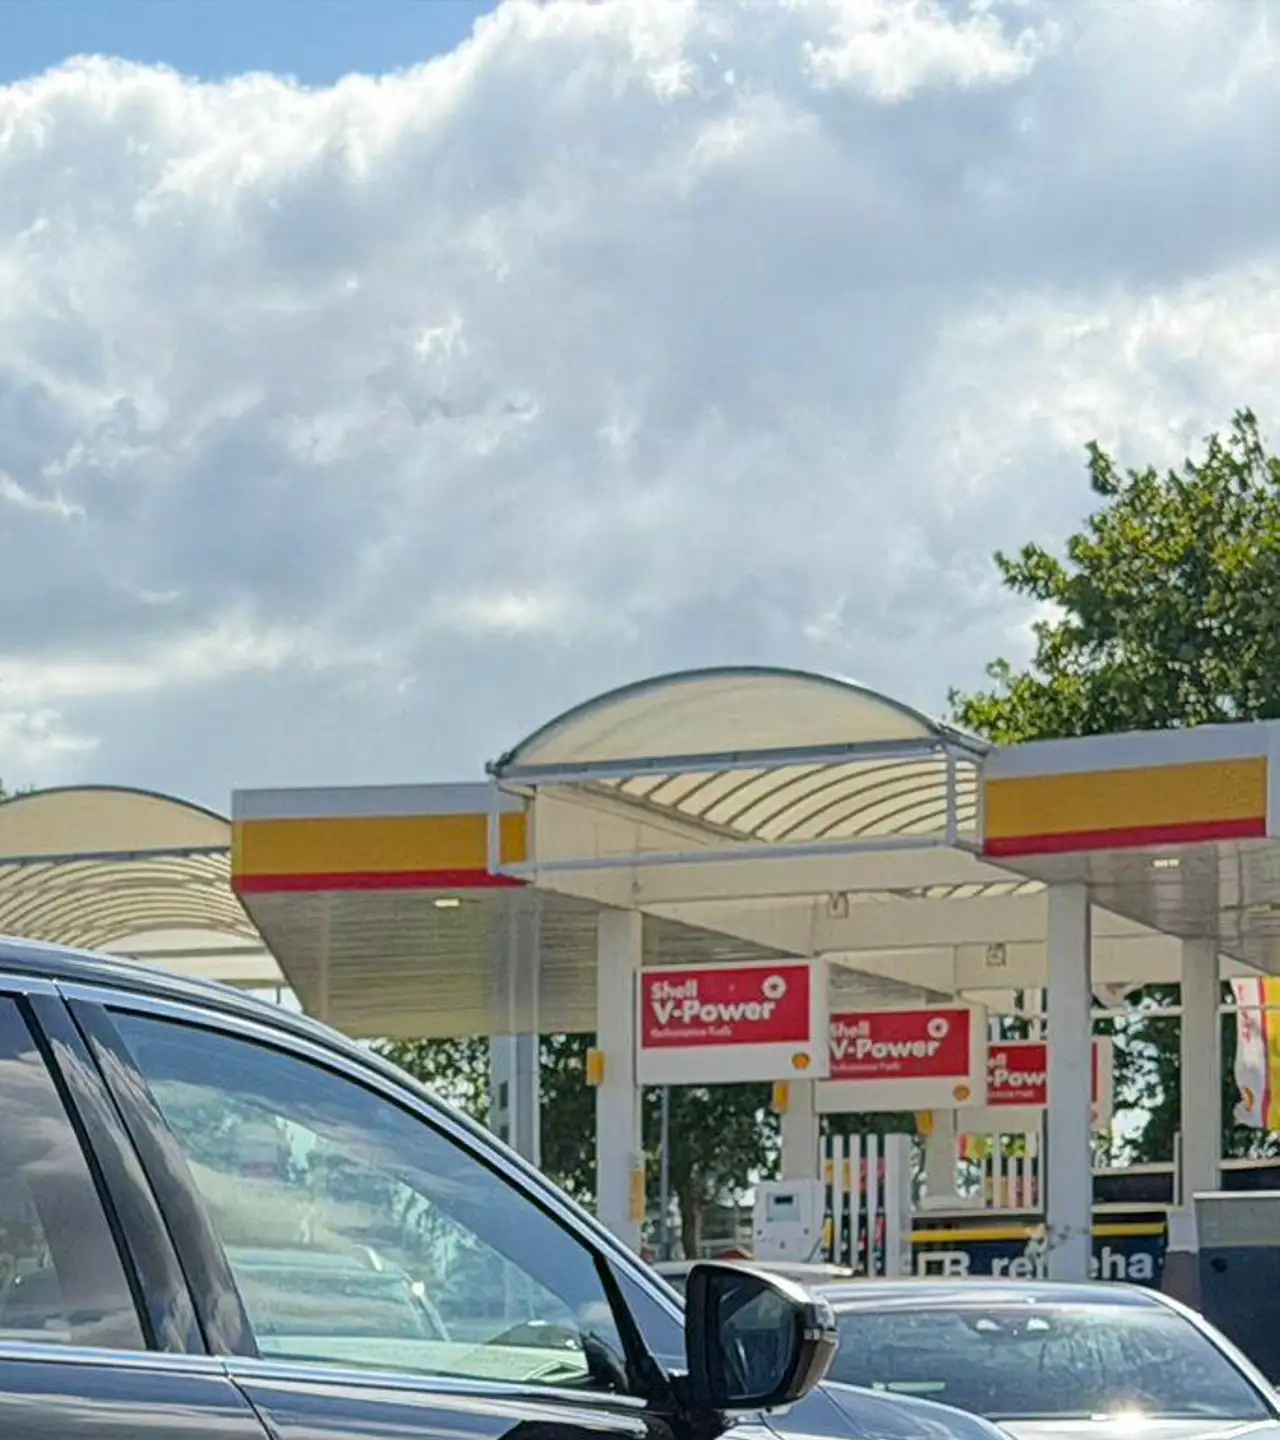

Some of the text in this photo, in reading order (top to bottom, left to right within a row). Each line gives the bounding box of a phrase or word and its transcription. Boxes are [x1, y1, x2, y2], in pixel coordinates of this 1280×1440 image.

[651, 979, 698, 999] Shell
[651, 999, 776, 1025] V-Power
[830, 1038, 941, 1060] V-Power
